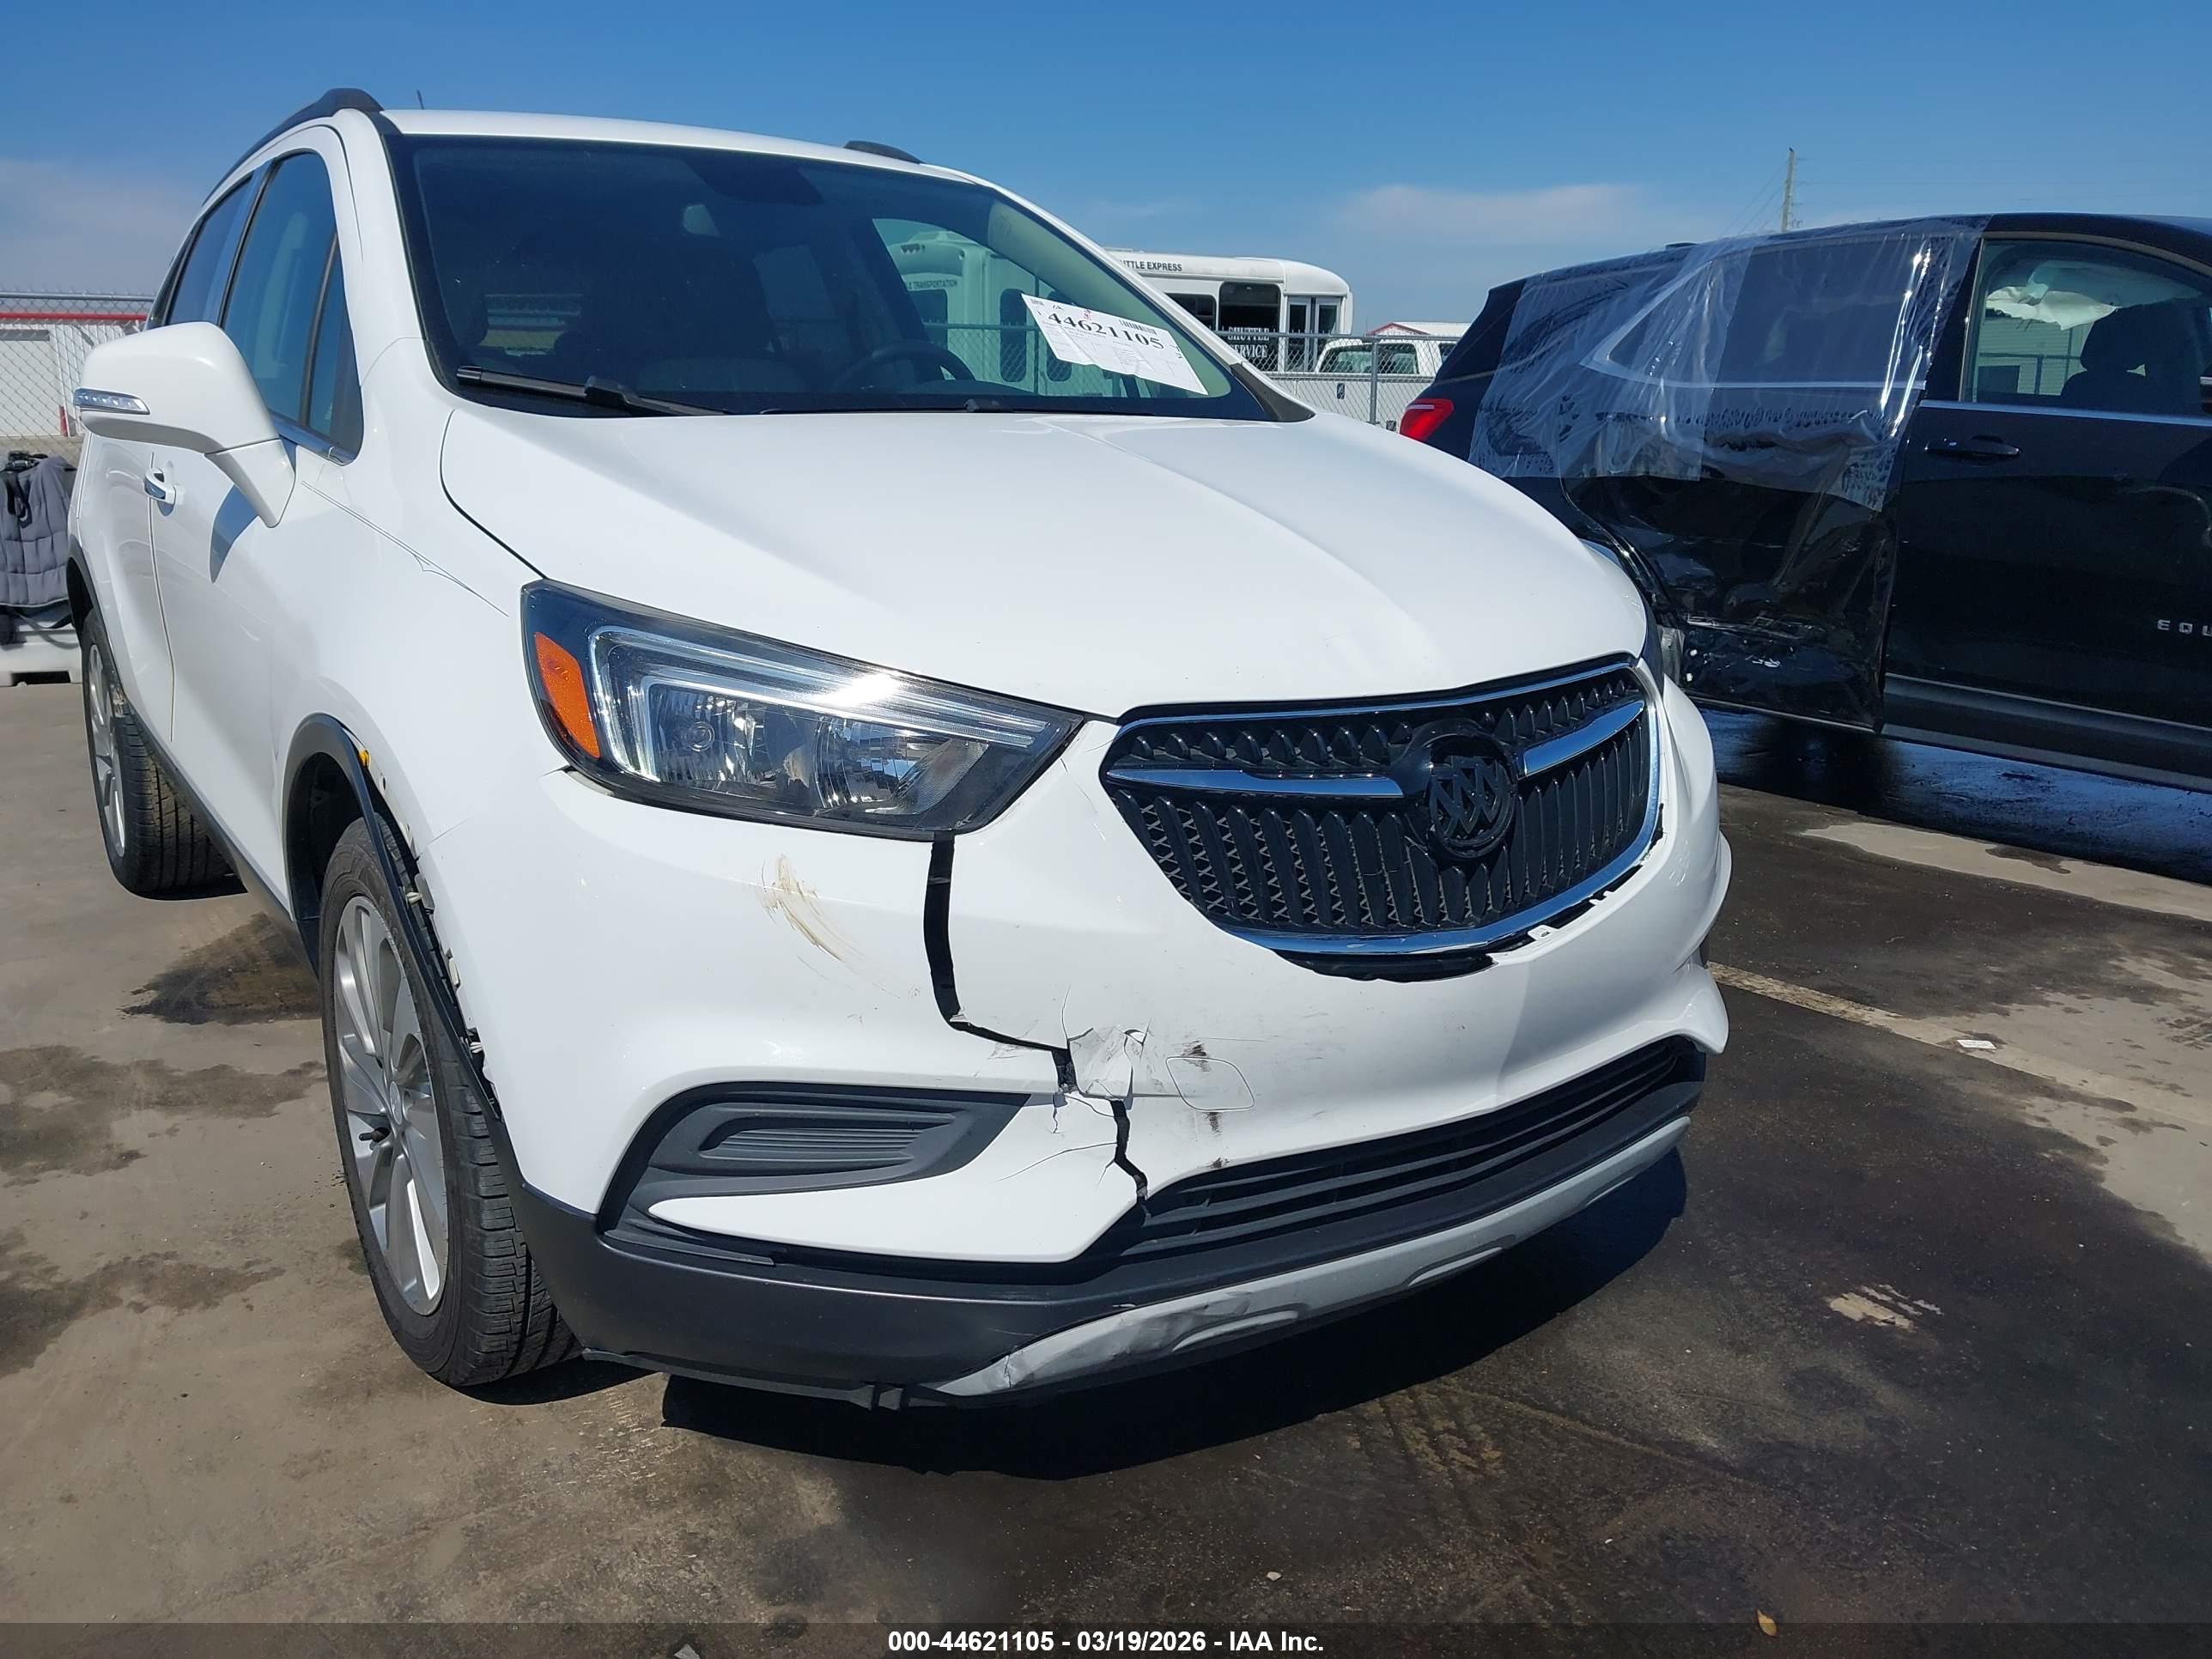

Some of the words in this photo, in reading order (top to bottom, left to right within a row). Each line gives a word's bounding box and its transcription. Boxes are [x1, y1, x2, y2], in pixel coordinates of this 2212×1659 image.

[1146, 261, 1182, 272] EXPRESS
[1048, 313, 1164, 350] 44621105
[1228, 326, 1270, 341] SHUTTLE
[1230, 343, 1268, 358] ERVICE
